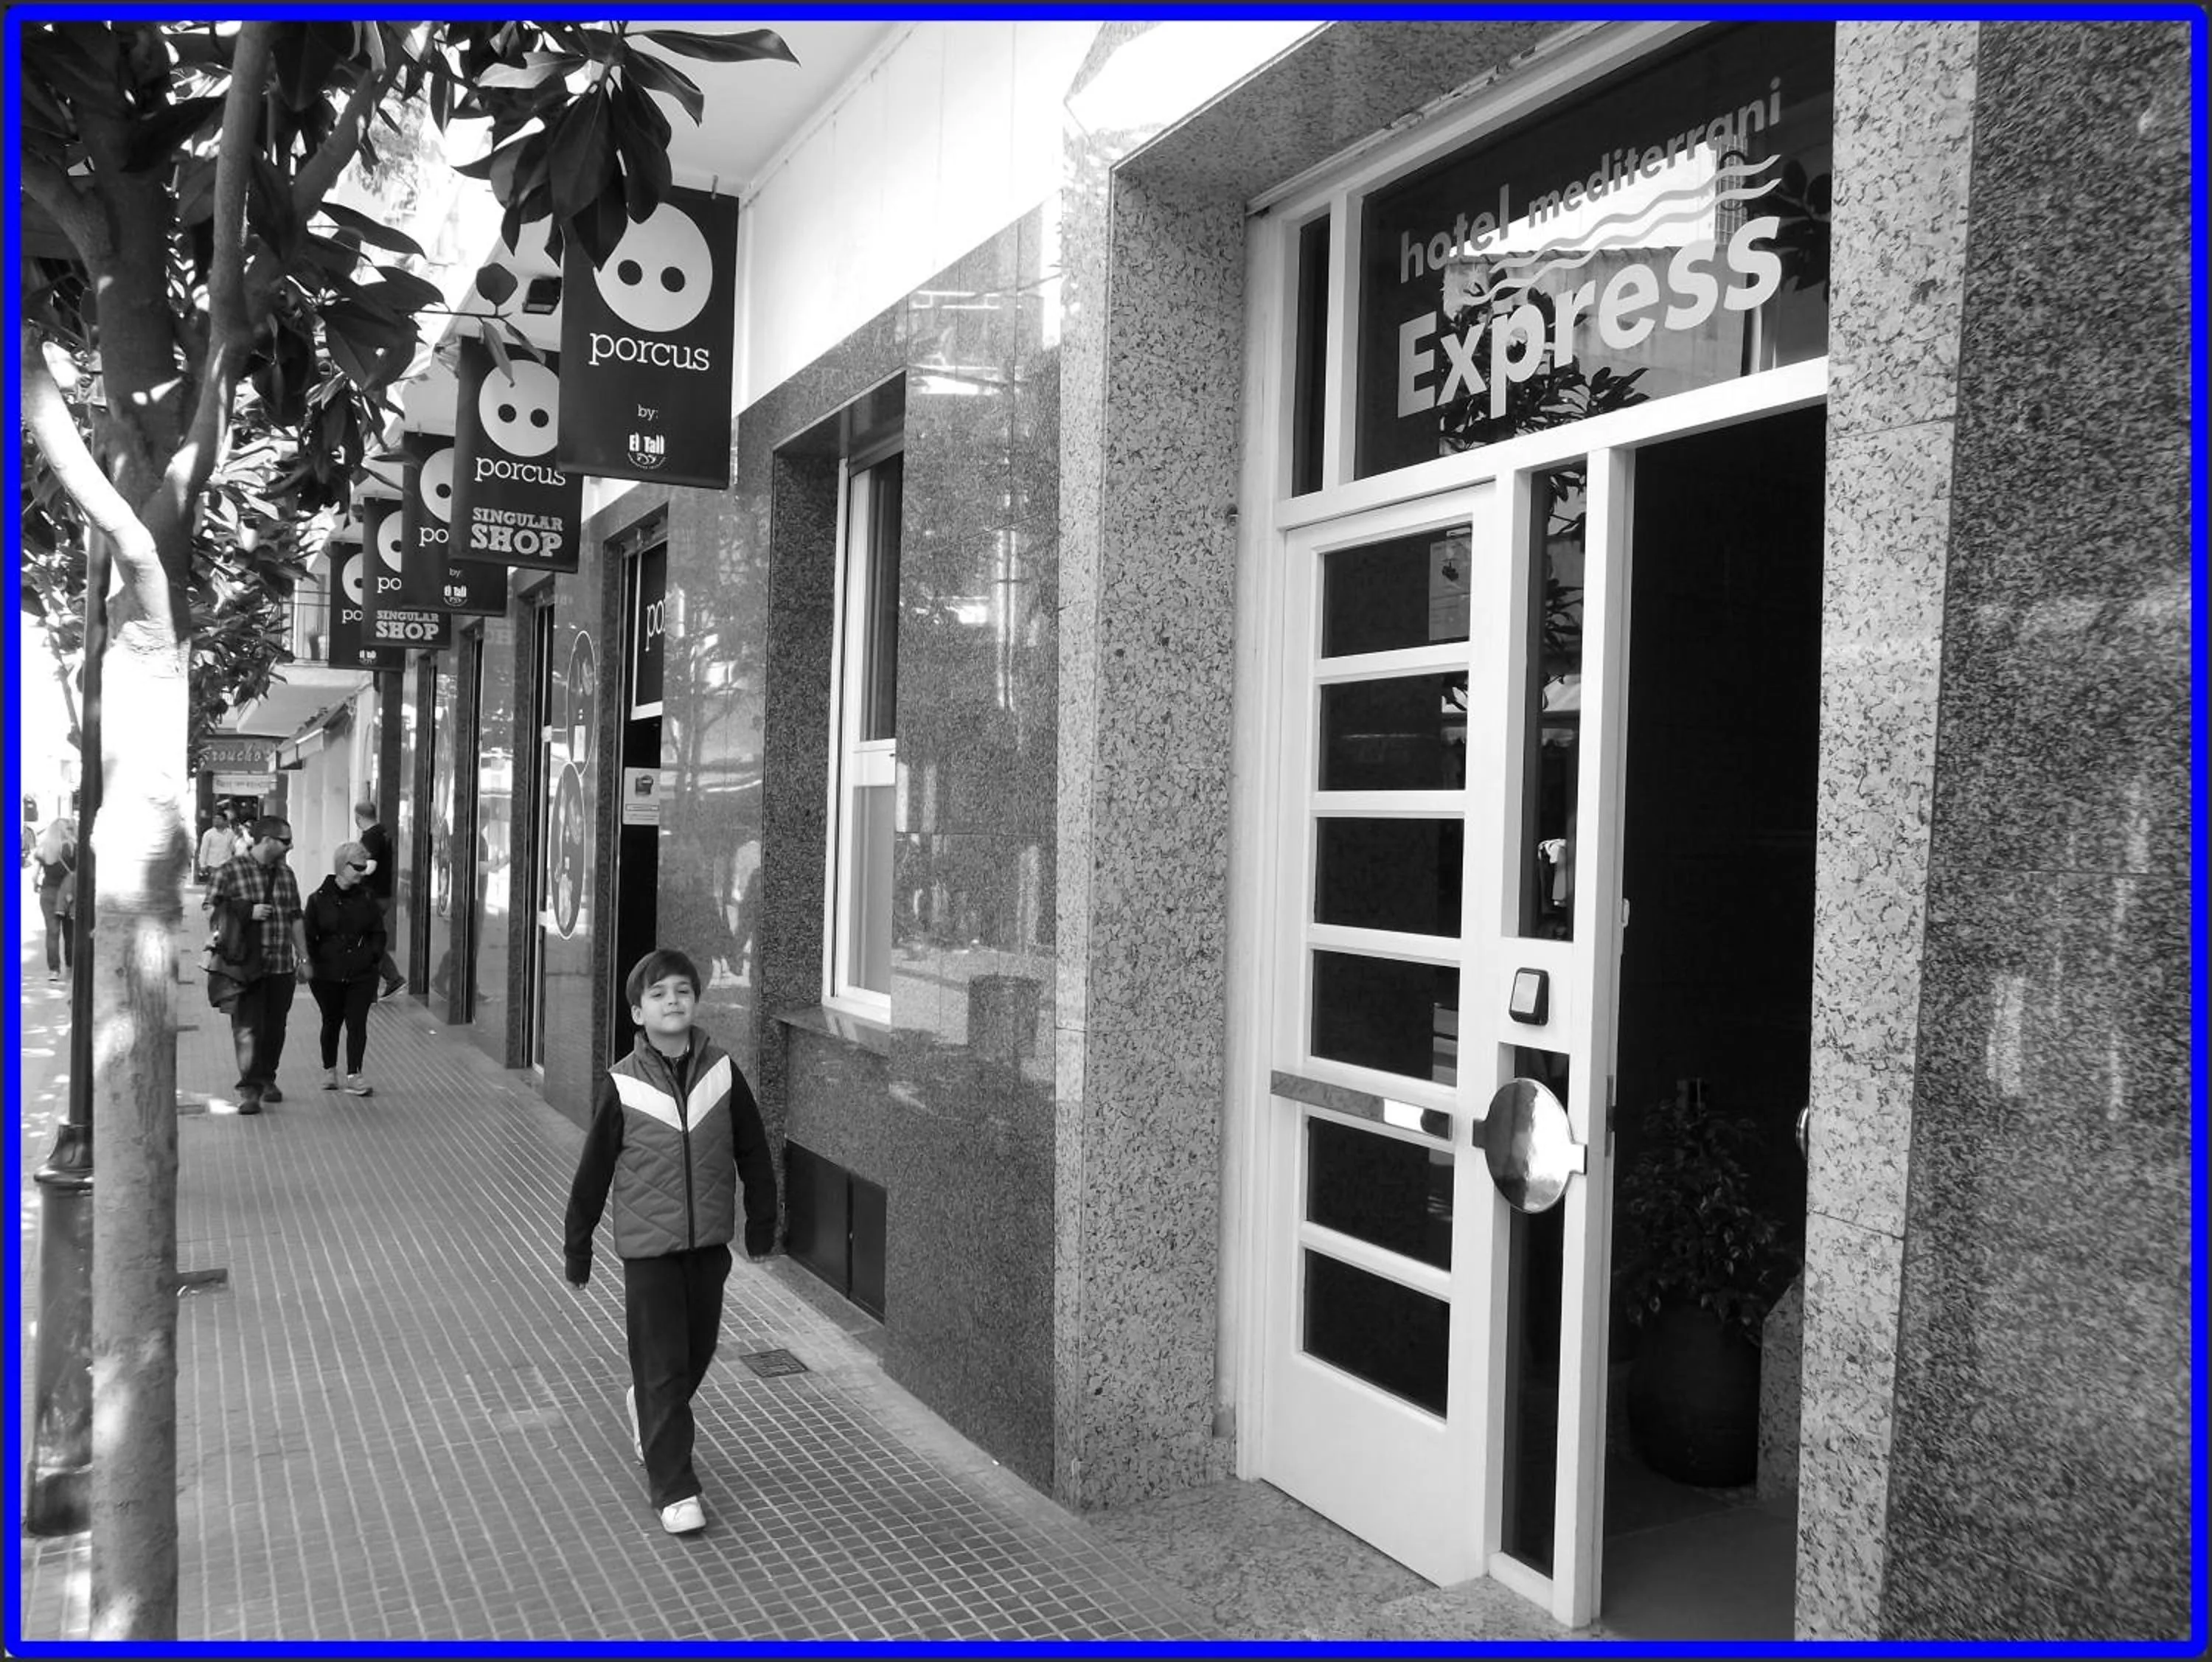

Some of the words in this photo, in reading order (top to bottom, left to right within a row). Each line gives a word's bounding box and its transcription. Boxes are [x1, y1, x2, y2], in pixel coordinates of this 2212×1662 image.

[1400, 184, 1510, 283] hotel
[1528, 76, 1782, 228] mediterrani
[1397, 215, 1783, 419] Express
[588, 333, 710, 371] porcus
[644, 434, 665, 455] Tall
[474, 456, 566, 486] porcus
[472, 507, 563, 532] SINGULAR
[470, 523, 563, 557] SHOP
[375, 621, 439, 641] SHOP
[377, 610, 439, 622] SINGULAR
